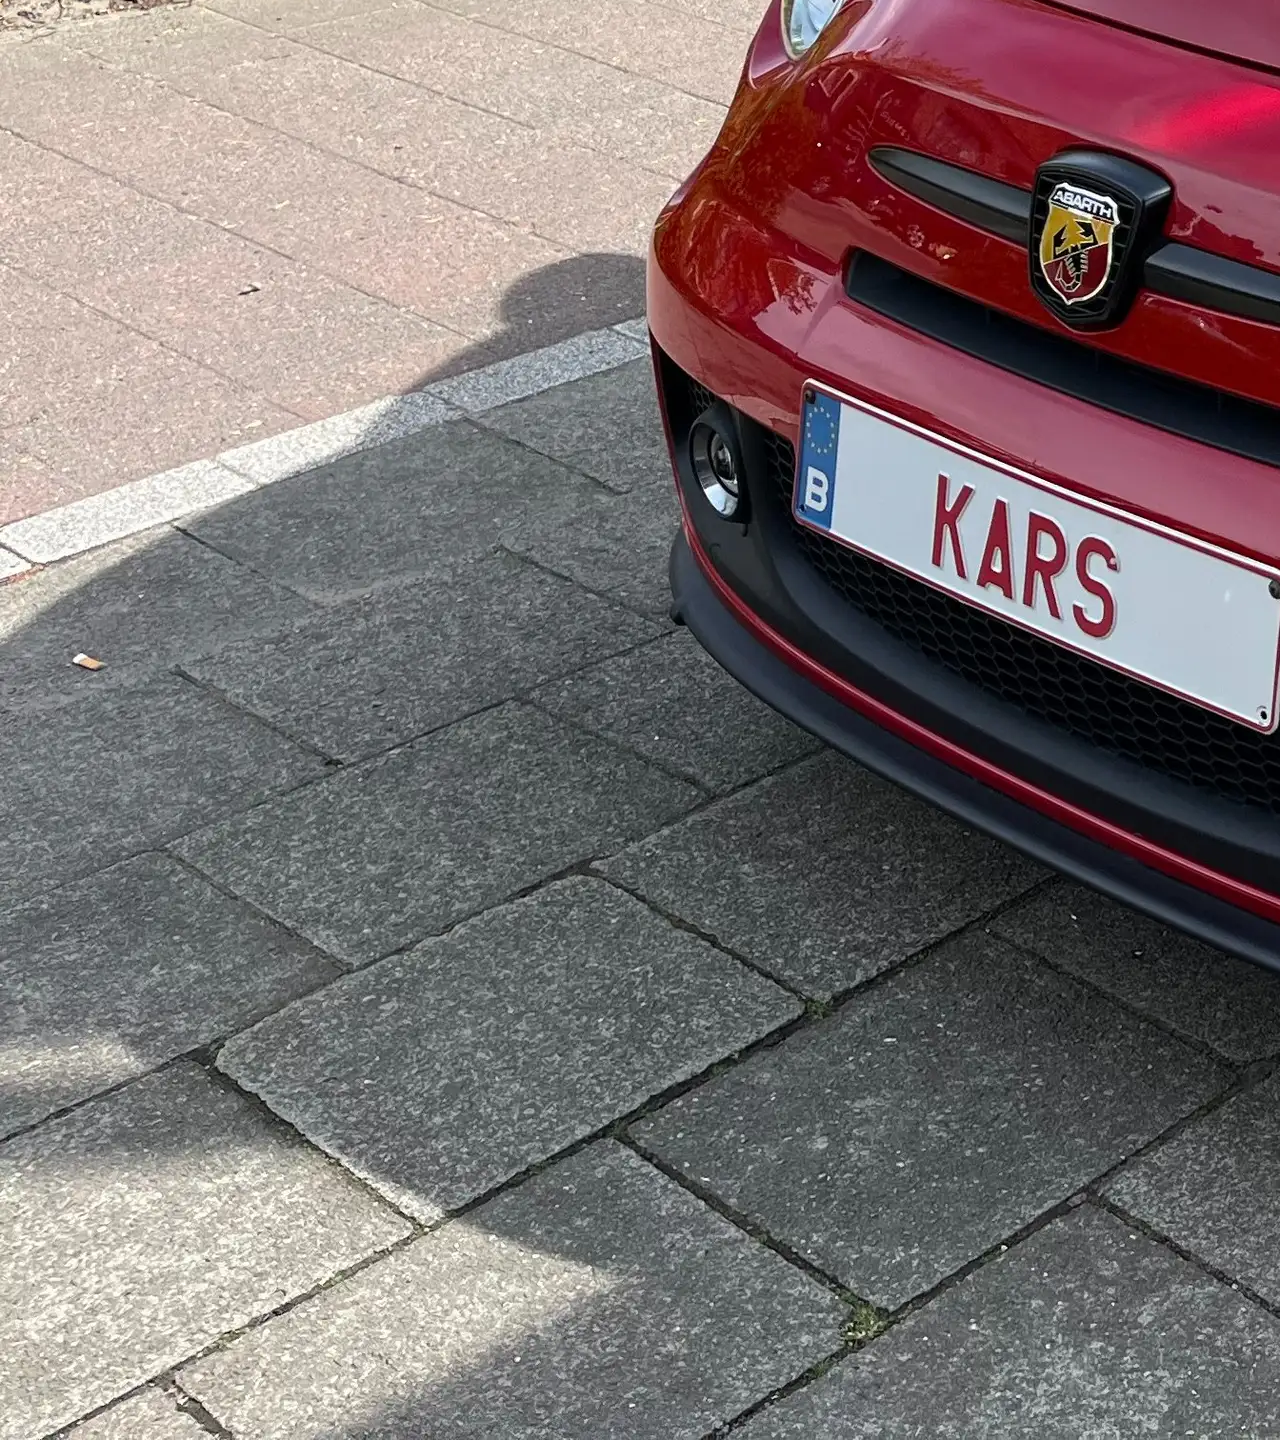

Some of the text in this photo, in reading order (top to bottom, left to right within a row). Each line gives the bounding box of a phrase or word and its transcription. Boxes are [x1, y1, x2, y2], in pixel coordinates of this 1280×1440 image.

[1053, 190, 1112, 218] ABARTH
[804, 465, 829, 512] B
[931, 471, 1121, 639] KARS
